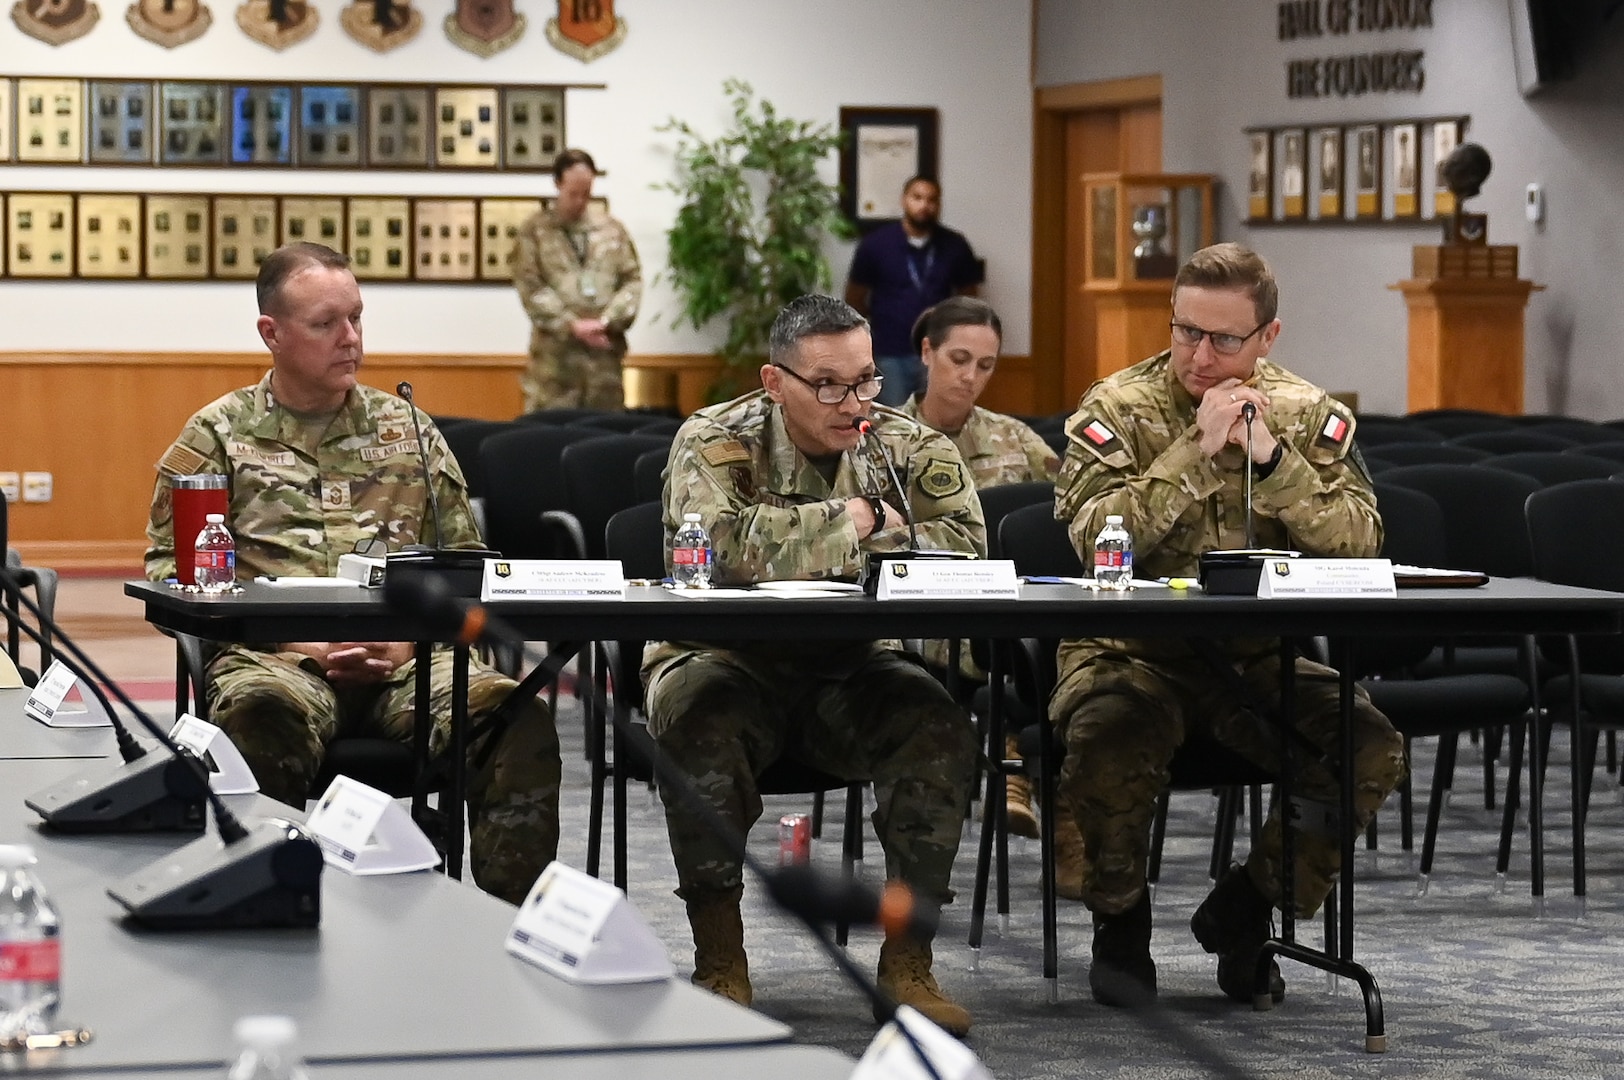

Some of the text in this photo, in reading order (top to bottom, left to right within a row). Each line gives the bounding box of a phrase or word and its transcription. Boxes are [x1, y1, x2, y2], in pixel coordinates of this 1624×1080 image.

[1278, 0, 1323, 41] HALL
[1326, 0, 1351, 36] OF
[1287, 48, 1426, 98] THE FOUNDERS
[399, 441, 420, 453] FORC
